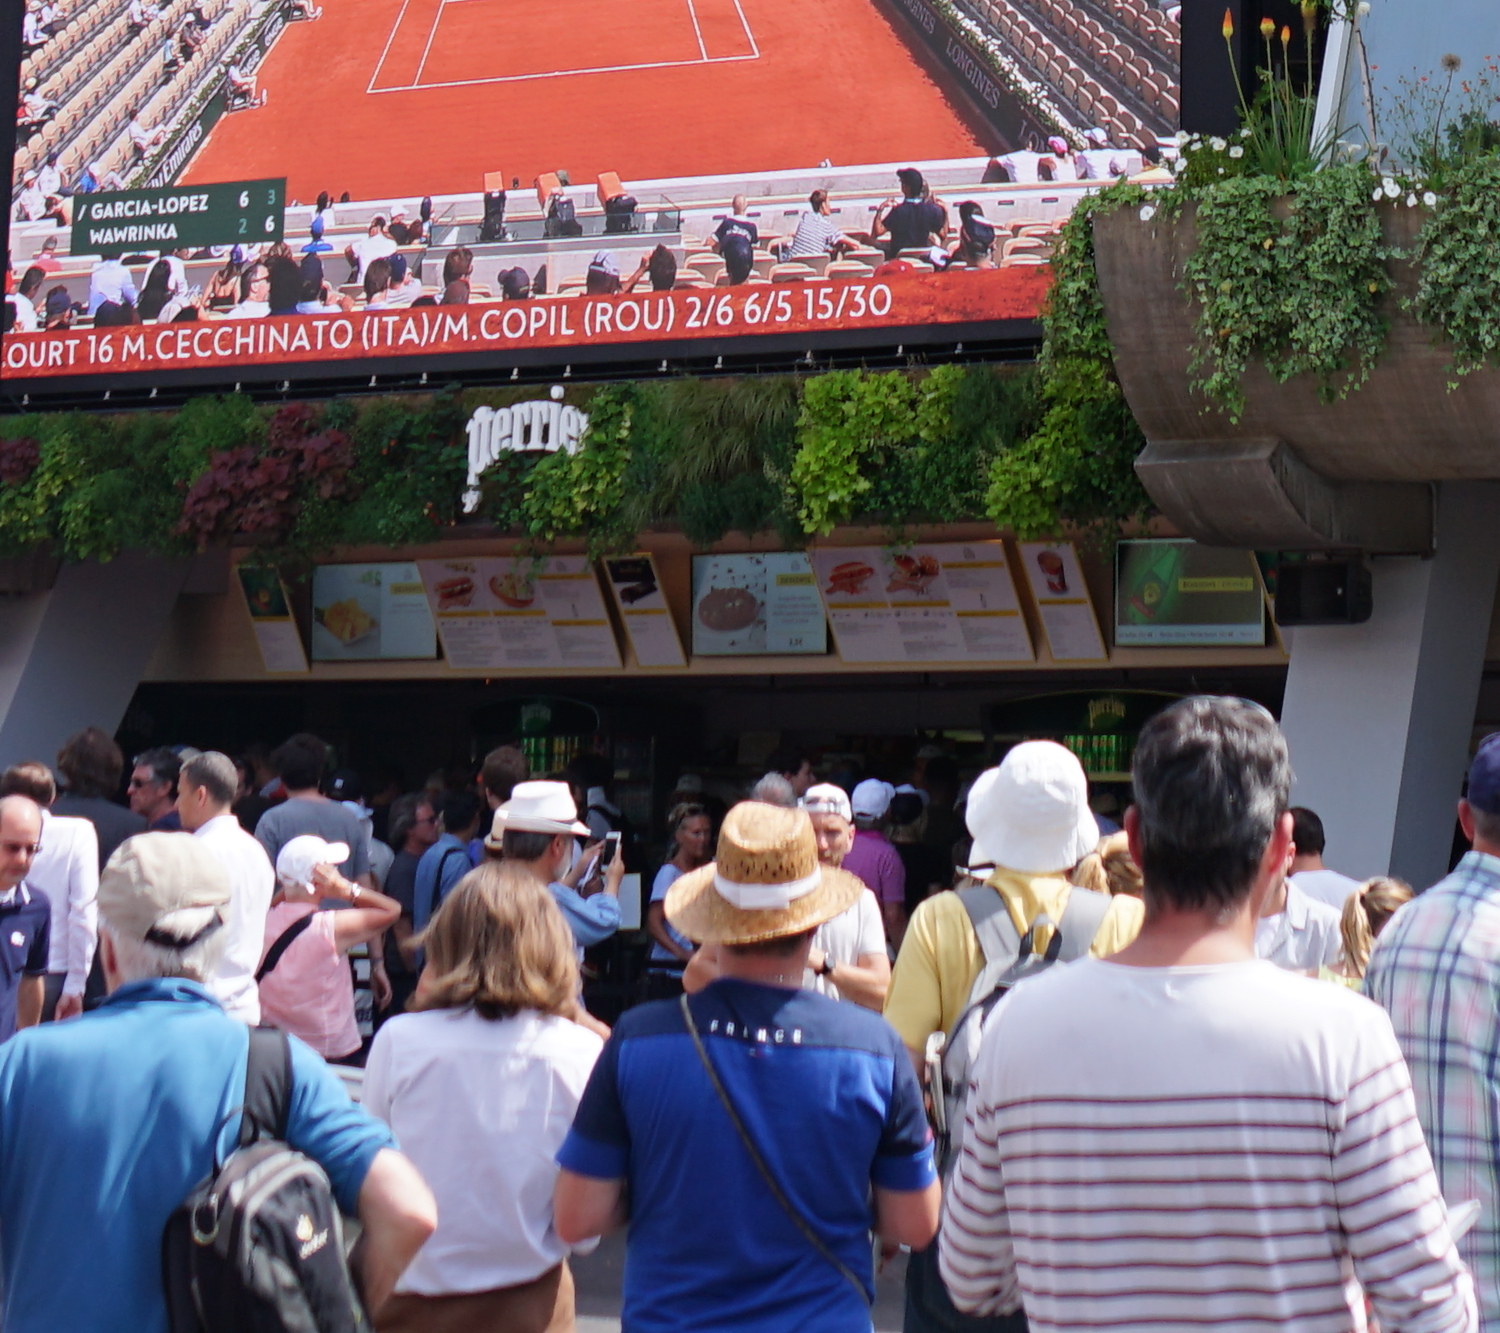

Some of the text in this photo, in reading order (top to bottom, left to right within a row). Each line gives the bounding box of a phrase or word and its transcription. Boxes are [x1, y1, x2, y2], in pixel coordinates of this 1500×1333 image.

[947, 38, 1000, 109] LONGINES
[162, 126, 202, 182] Emirates
[89, 215, 275, 245] WAWRINKA 2 6
[91, 189, 276, 220] GARCIA-LOPEZ 6 3
[1, 339, 80, 369] OURT
[88, 335, 114, 364] 16
[122, 319, 351, 362] M.CECCHINATO
[583, 296, 676, 338] (ROU)
[685, 292, 734, 329] 2/6
[743, 290, 793, 324] 6/5
[804, 284, 893, 321] 15/30
